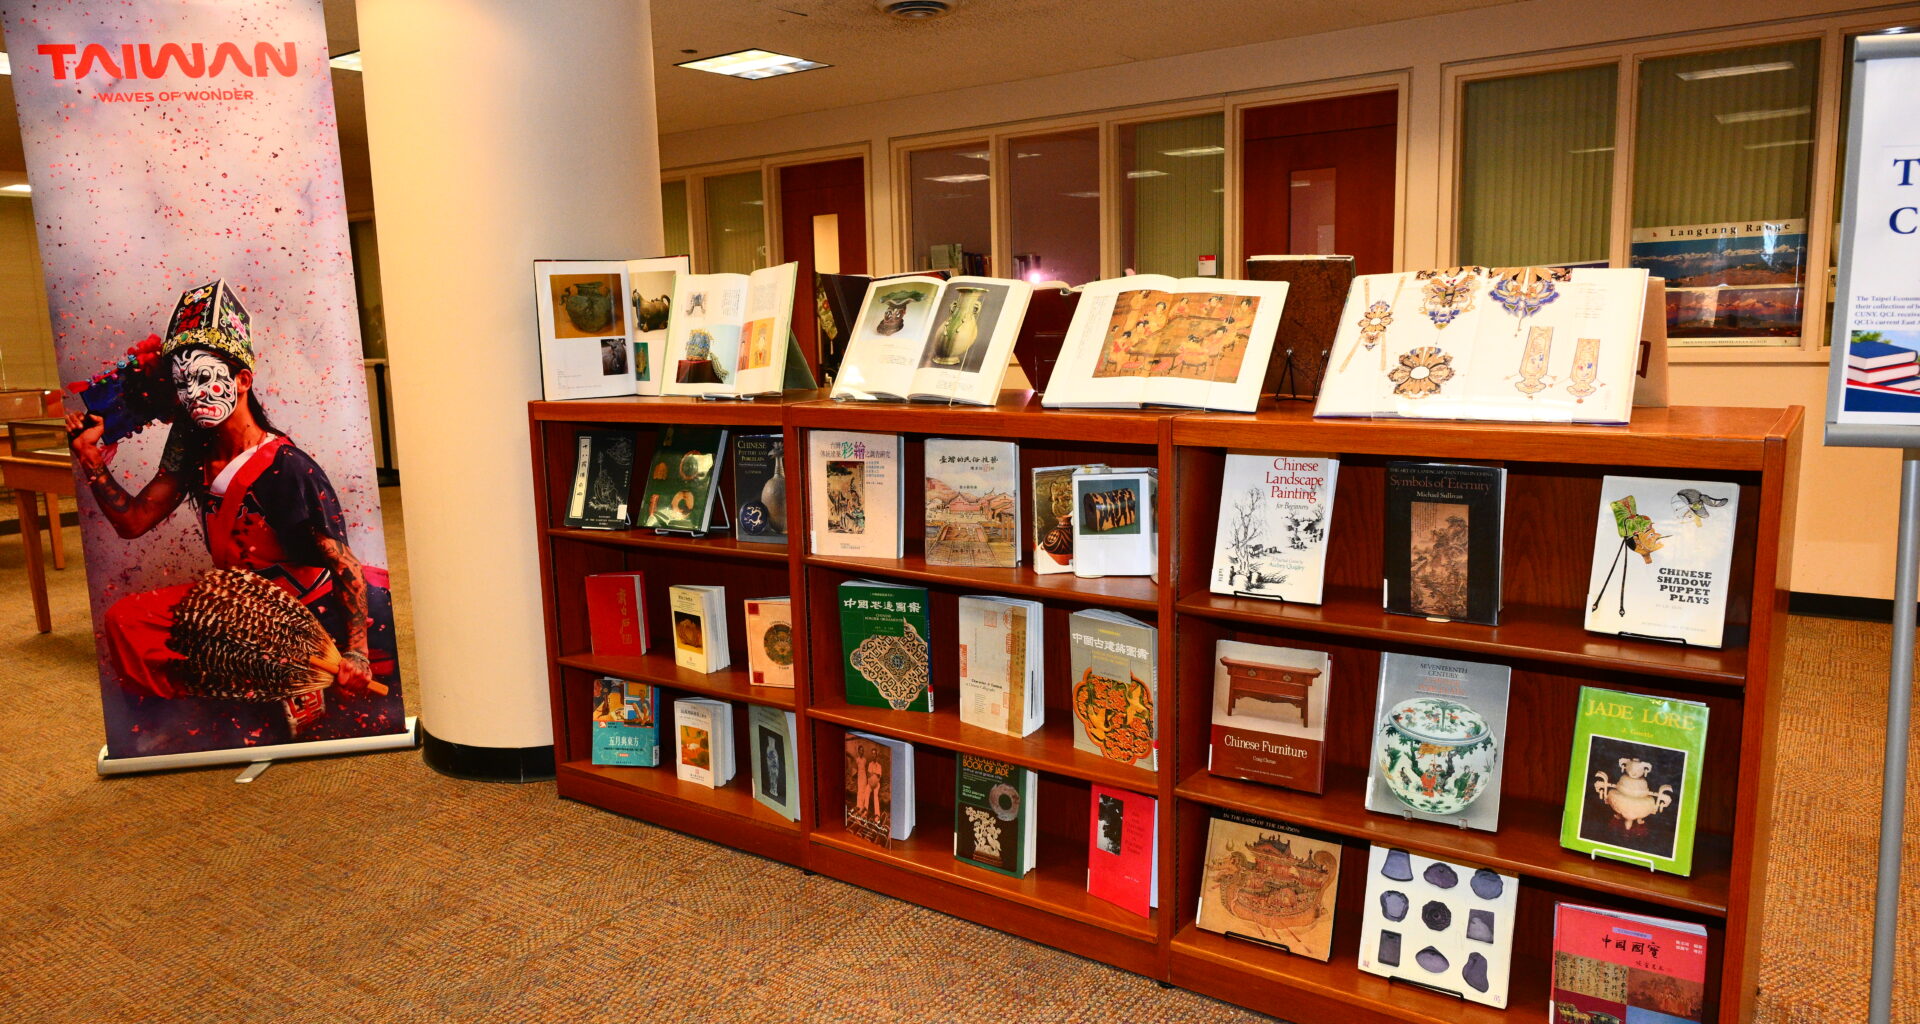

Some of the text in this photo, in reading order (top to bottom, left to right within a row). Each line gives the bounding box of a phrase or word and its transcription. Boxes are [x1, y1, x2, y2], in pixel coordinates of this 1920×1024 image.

[38, 42, 298, 80] TAIWAN
[98, 90, 254, 103] WAVES OF WONDER
[1670, 226, 1737, 237] Langtang
[738, 440, 768, 449] CHINESE
[1273, 457, 1319, 472] Chinese
[1266, 471, 1324, 490] Landscape
[1390, 474, 1492, 495] Symbols of Eternity
[1271, 485, 1318, 504] Painting
[1440, 491, 1463, 499] Sullivan
[1284, 502, 1309, 511] Beginners
[1658, 567, 1712, 580] CHINESE
[1657, 575, 1711, 588] SHADOW
[1659, 584, 1710, 596] PUPPET
[1669, 593, 1710, 605] PLAYS
[1420, 663, 1468, 674] SEVENTEENTH
[1427, 670, 1459, 679] CENTURY
[1585, 699, 1697, 731] JADE LORE
[1224, 734, 1308, 759] Chinese Furniture
[962, 759, 983, 771] BOOK
[984, 763, 994, 773] OF
[994, 766, 1009, 778] JADE
